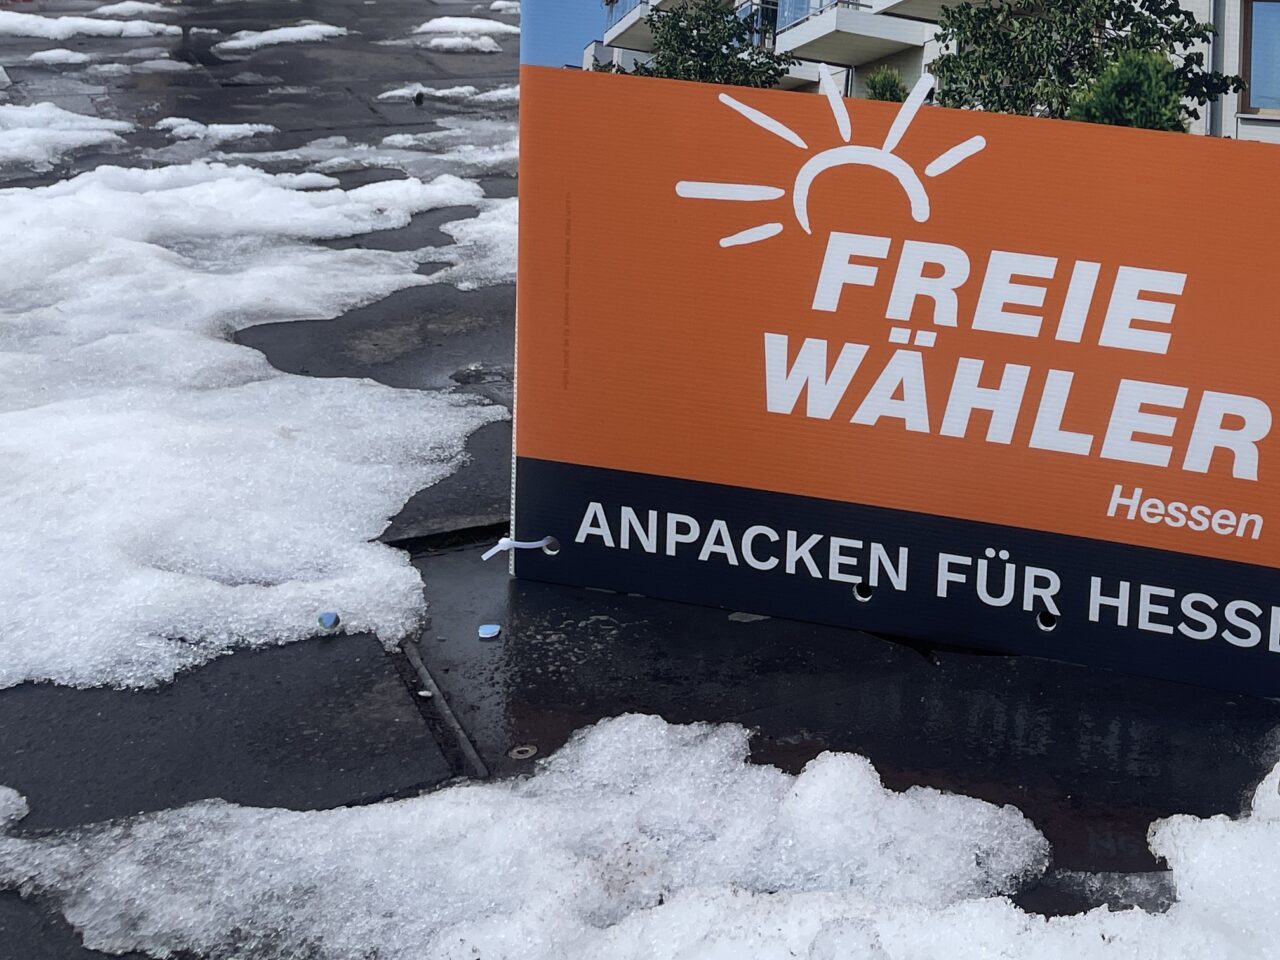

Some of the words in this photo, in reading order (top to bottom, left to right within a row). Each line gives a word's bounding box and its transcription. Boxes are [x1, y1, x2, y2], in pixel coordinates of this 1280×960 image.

[812, 232, 1188, 355] FREIE
[764, 327, 1273, 481] WÄHLER
[575, 501, 909, 591] ANPACKEN
[937, 547, 1061, 616] FÜR
[1106, 484, 1264, 540] Hessen
